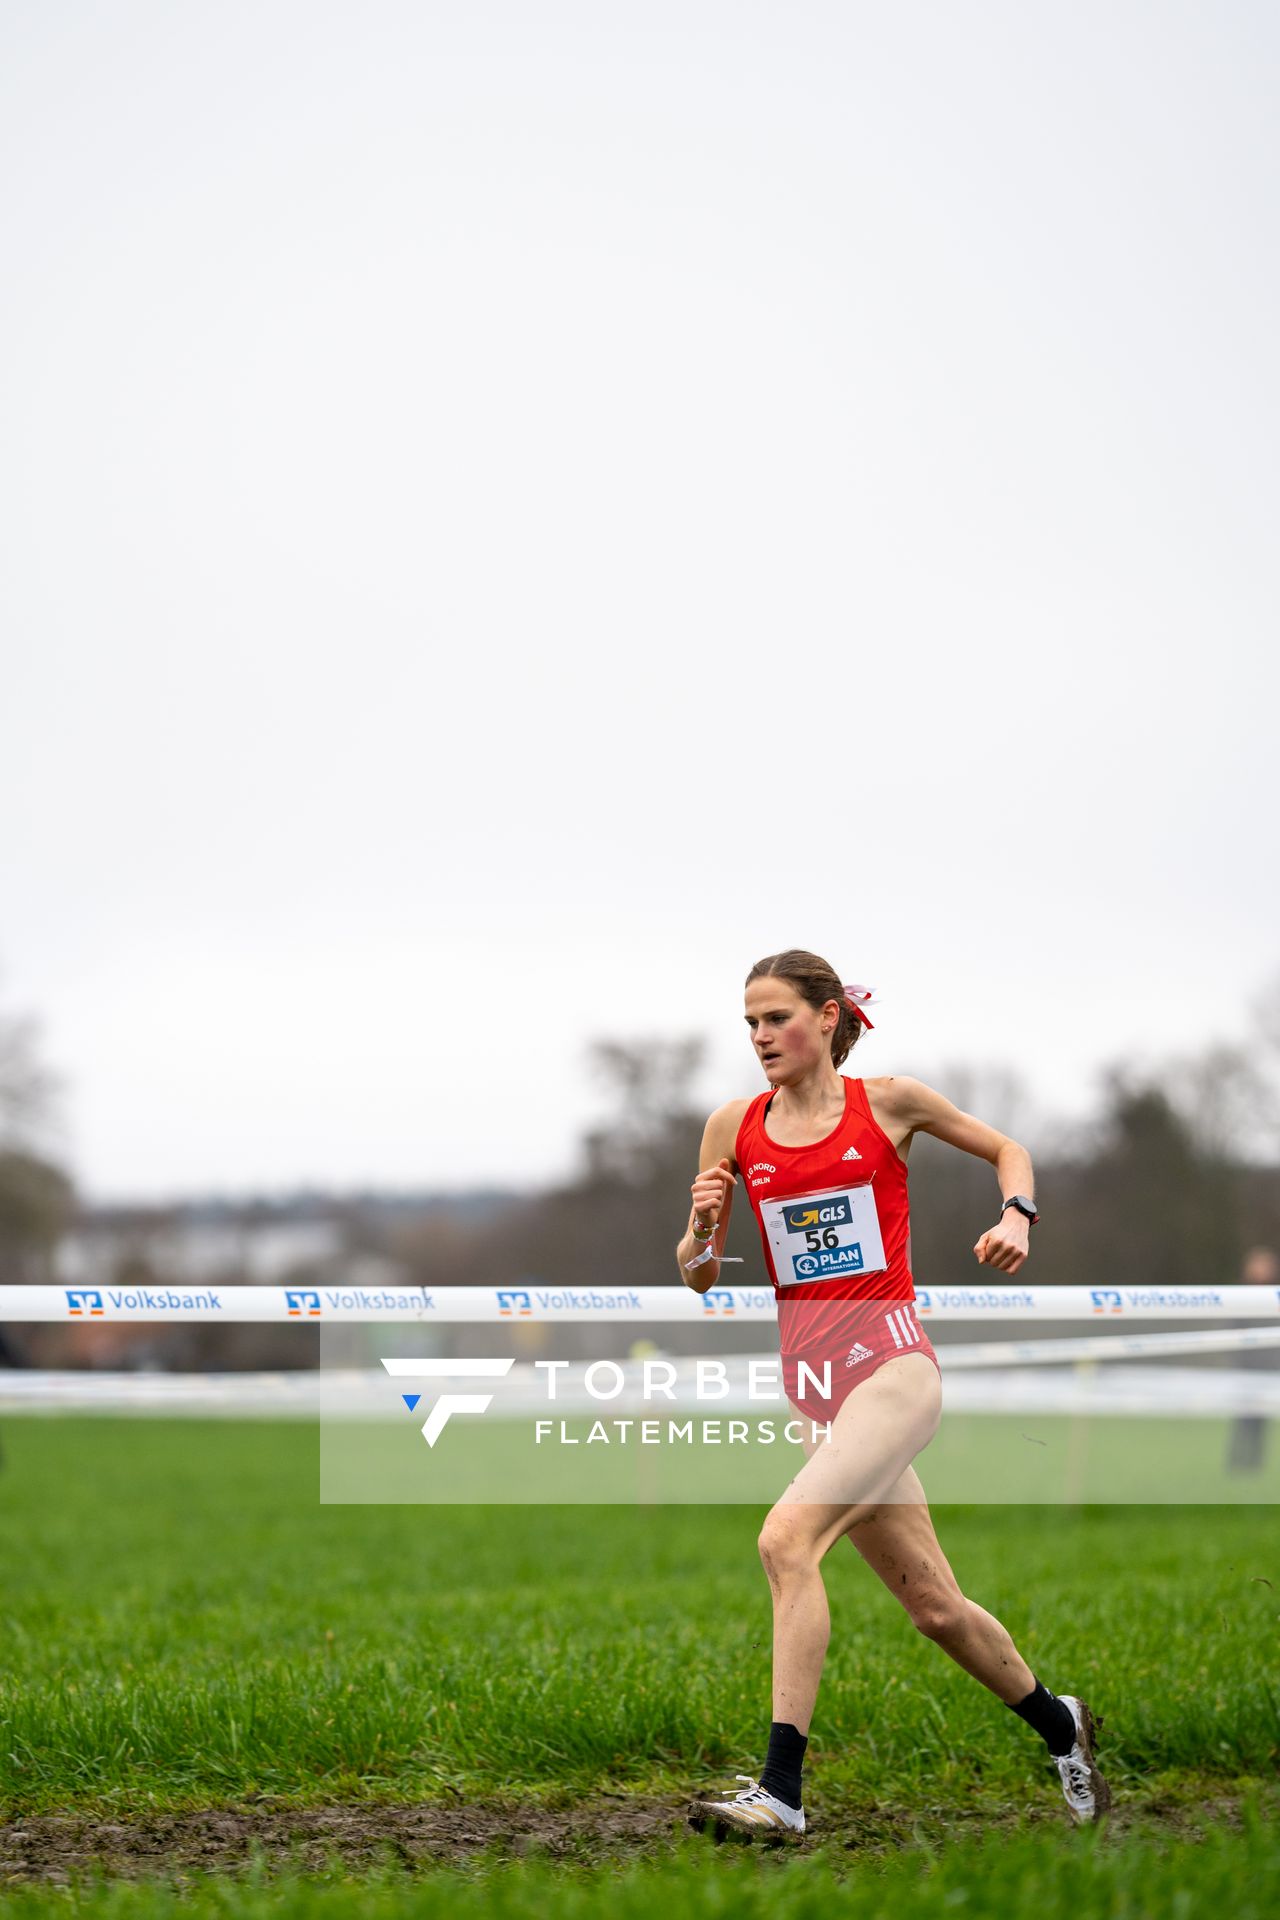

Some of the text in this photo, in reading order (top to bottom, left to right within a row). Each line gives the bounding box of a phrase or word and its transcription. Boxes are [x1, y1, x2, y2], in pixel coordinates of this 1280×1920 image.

[753, 1162, 776, 1173] NORD
[752, 1176, 770, 1187] BERLIN
[819, 1205, 845, 1223] GLS
[805, 1227, 839, 1253] 56
[820, 1249, 859, 1266] PLAN
[822, 1262, 860, 1271] INTERNATIONAL
[107, 1290, 222, 1310] Volksbank
[326, 1290, 436, 1310] Volksbank
[536, 1291, 642, 1310] Volksbank
[935, 1291, 1035, 1309] Volksbank
[1127, 1290, 1223, 1308] Volksbank
[845, 1350, 874, 1368] adidas
